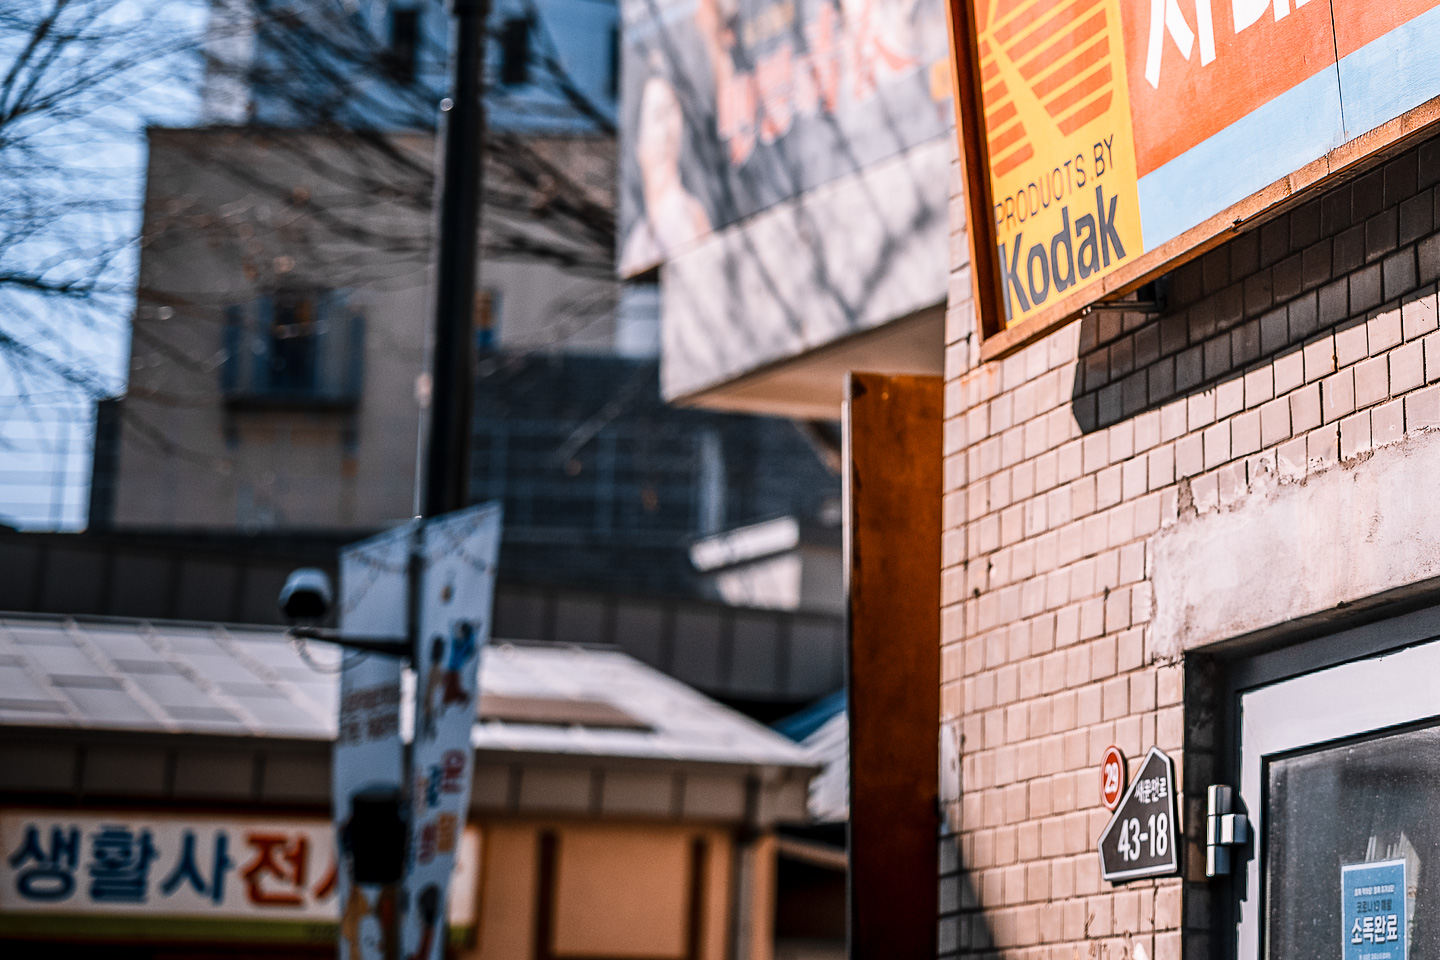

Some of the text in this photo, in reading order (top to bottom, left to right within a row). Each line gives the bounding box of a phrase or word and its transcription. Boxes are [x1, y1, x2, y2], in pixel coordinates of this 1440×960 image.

[998, 185, 1126, 322] Kodak
[1117, 812, 1168, 862] 43-18
[1350, 914, 1399, 945] 소독완료
